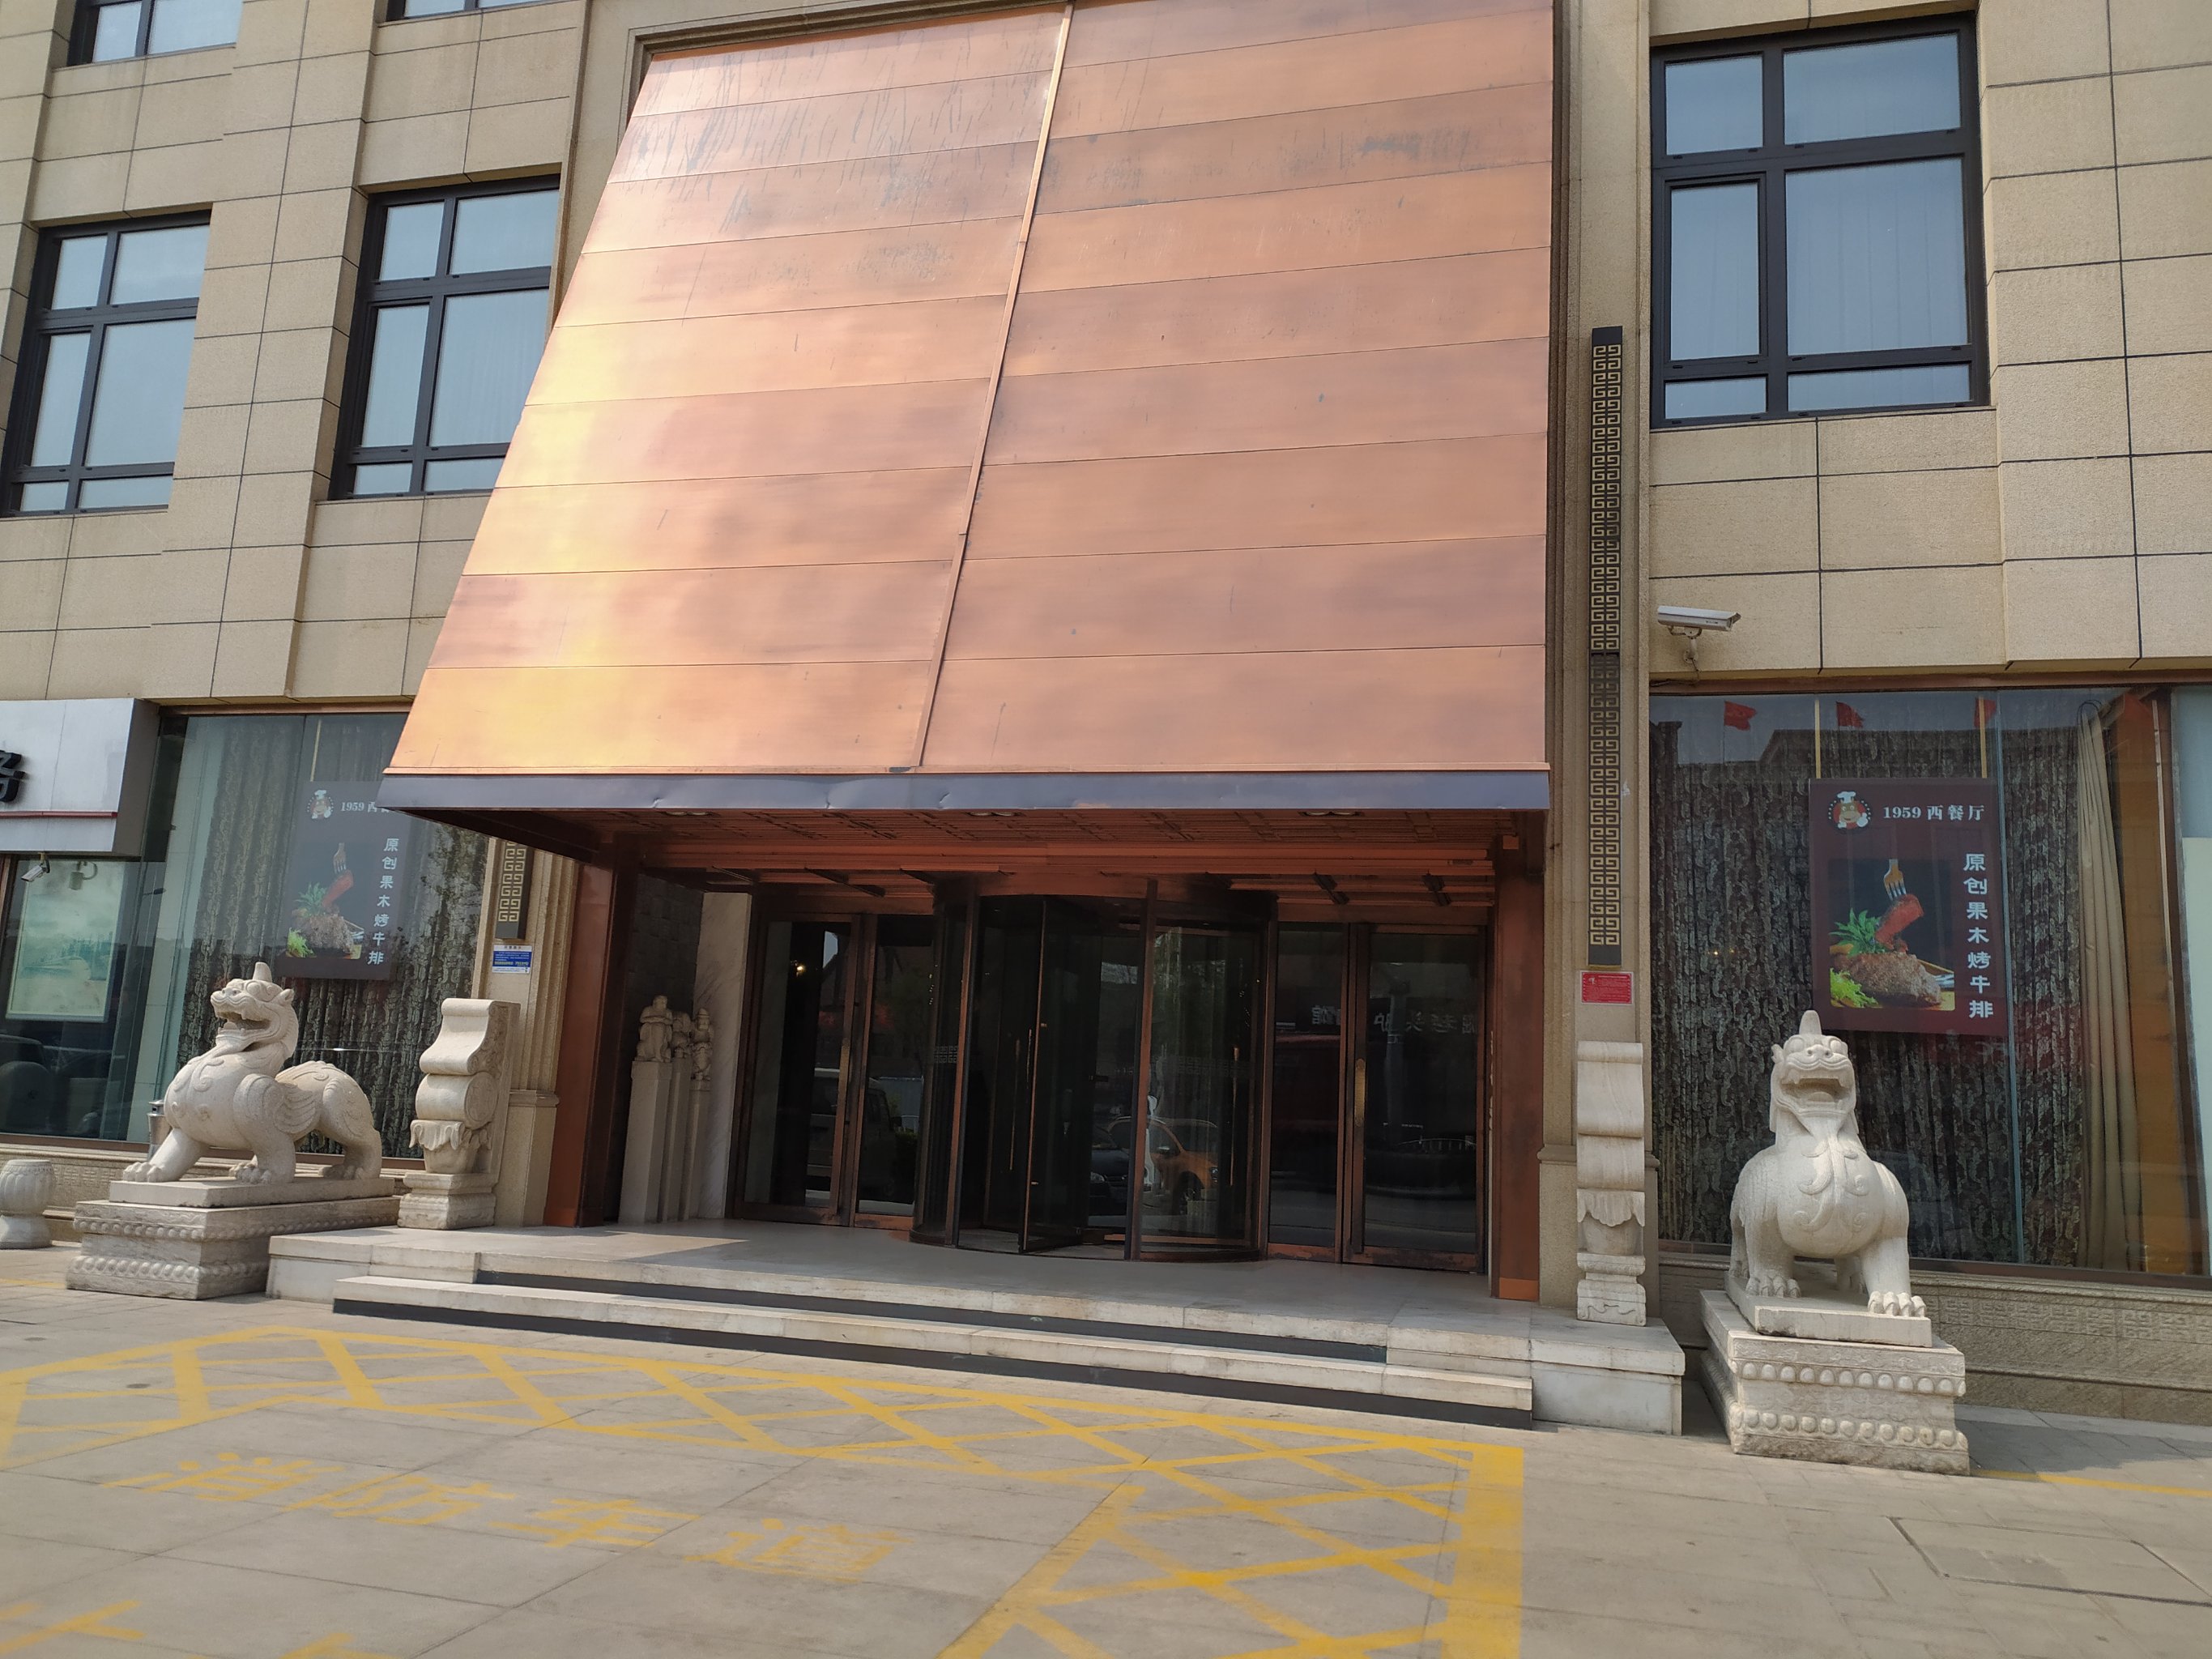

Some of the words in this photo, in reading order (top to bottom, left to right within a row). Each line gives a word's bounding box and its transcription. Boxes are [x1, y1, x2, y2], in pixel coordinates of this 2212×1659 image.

[367, 838, 399, 965] 原创果木烤牛排
[1963, 853, 1993, 1018] 原创果木烤牛排
[103, 1452, 914, 1583] 消防车道
